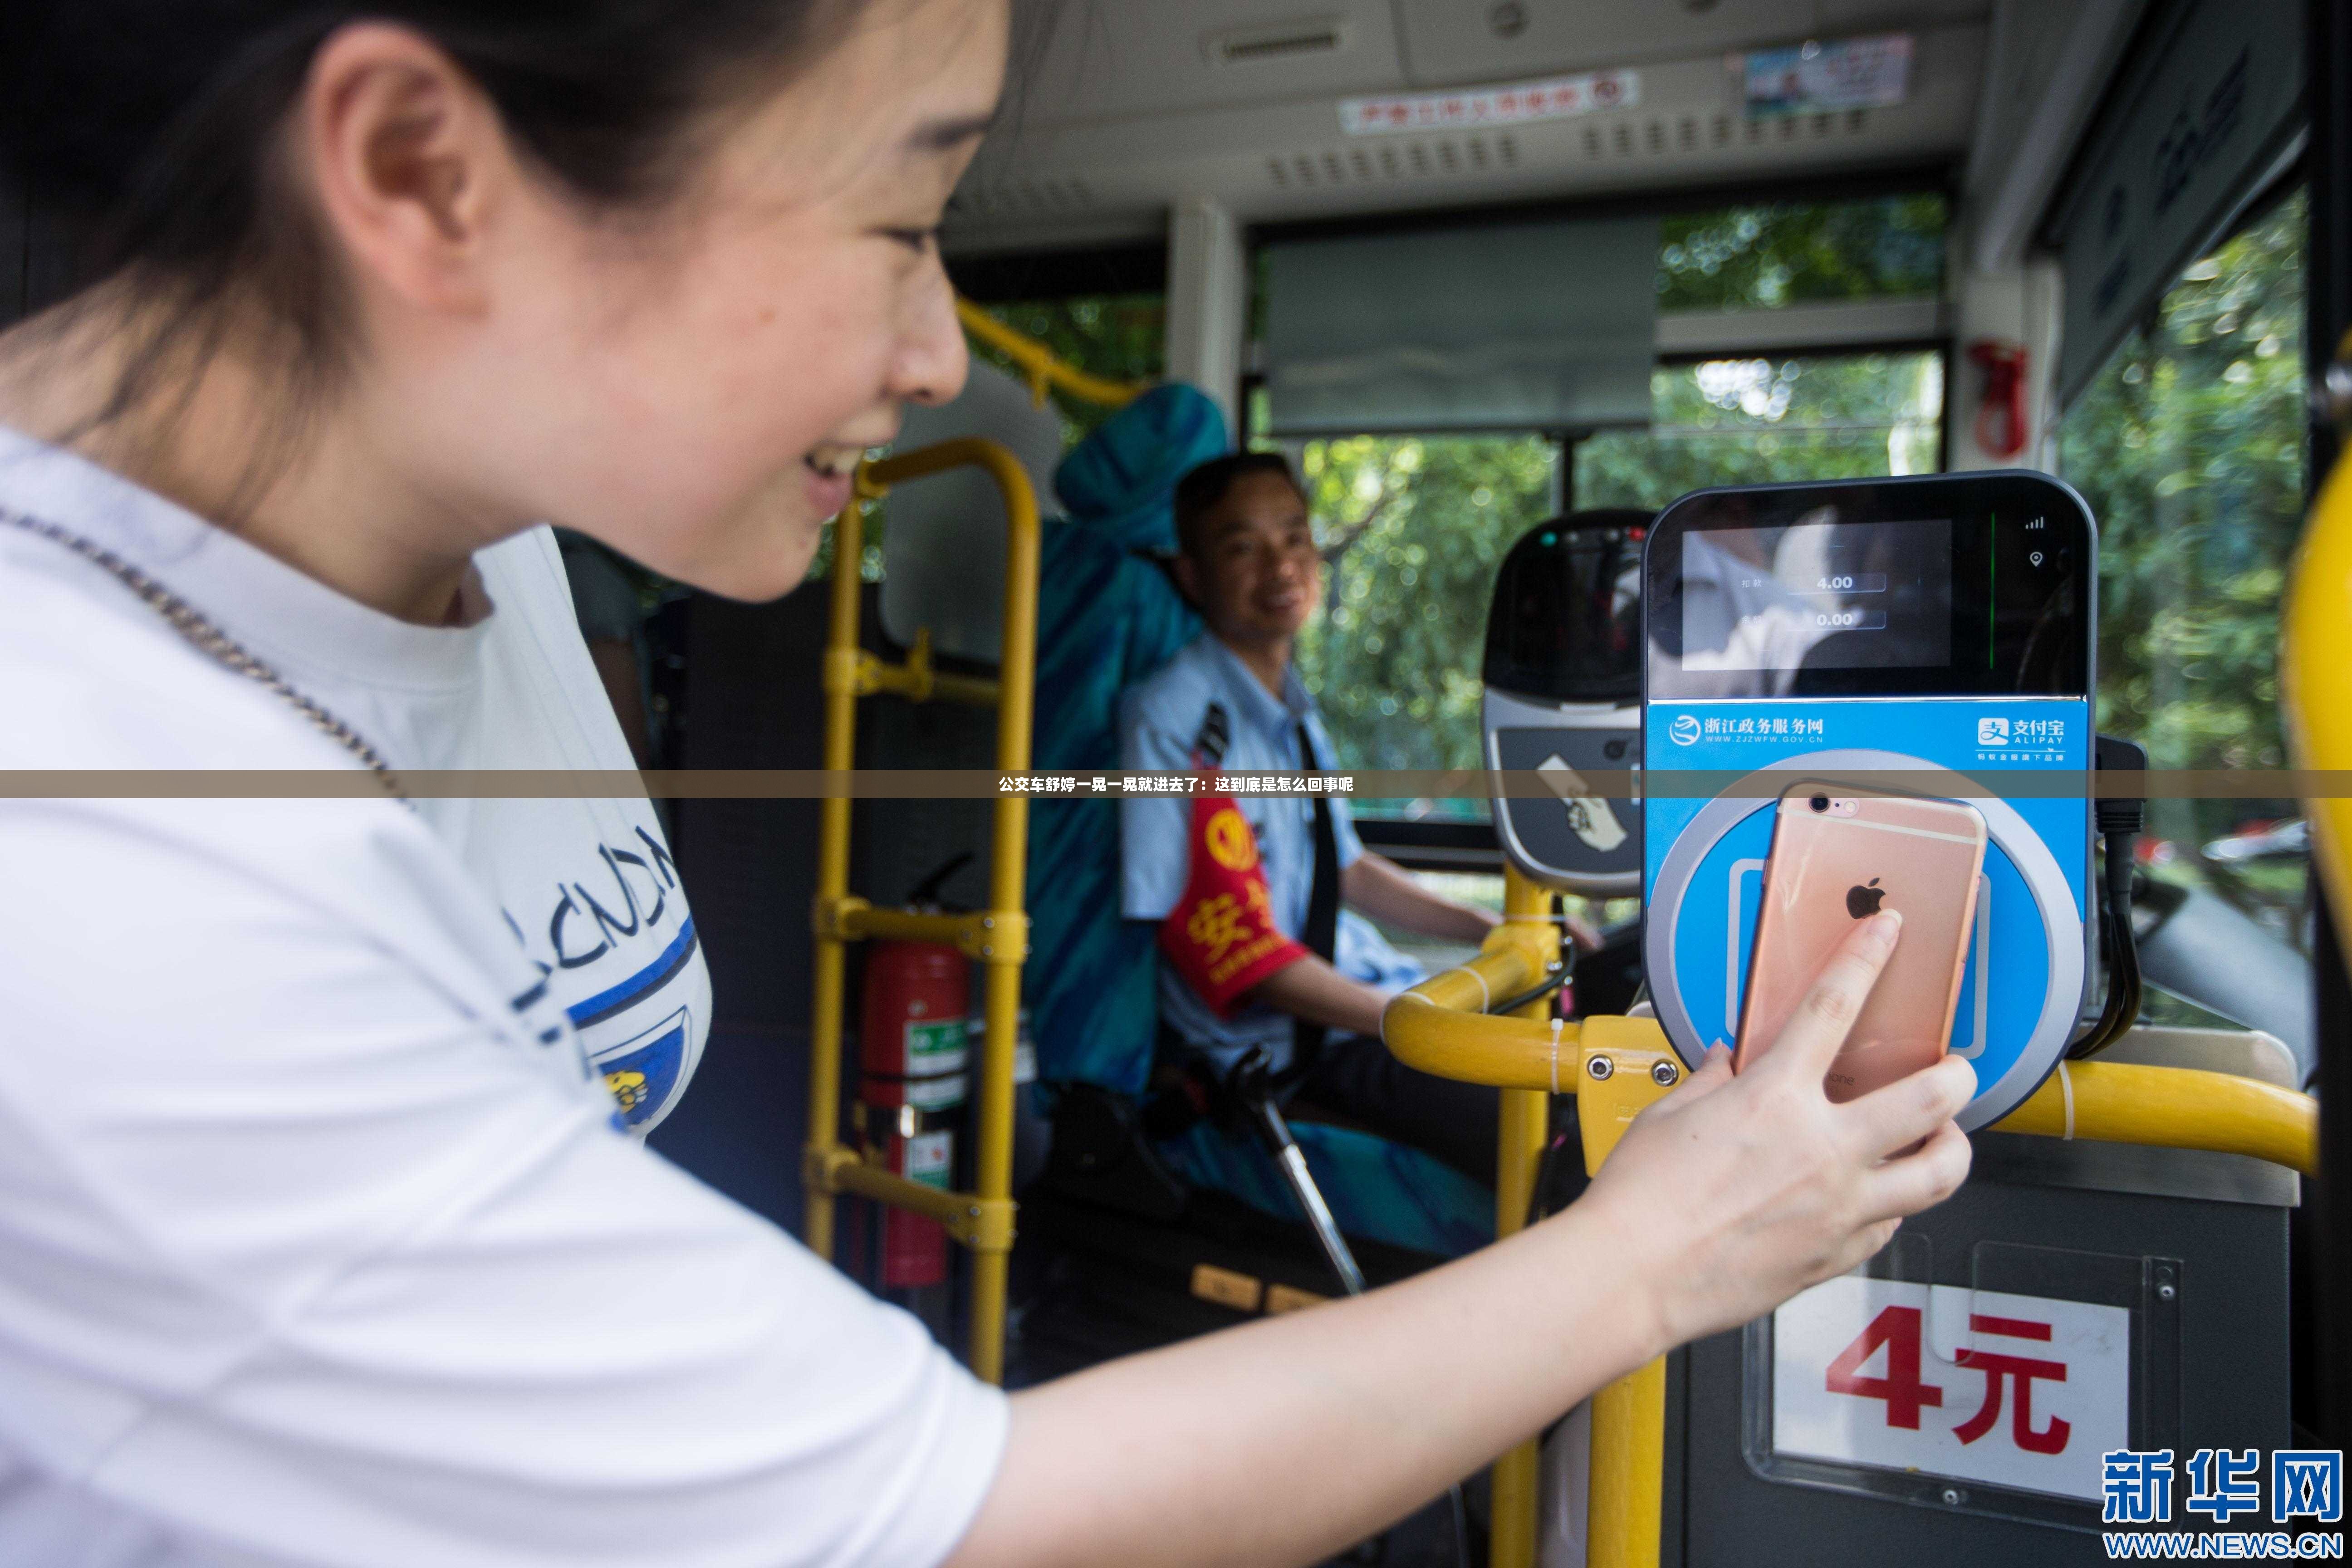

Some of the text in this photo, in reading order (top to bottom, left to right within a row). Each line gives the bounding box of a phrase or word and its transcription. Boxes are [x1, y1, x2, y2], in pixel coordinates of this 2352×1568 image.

[1817, 577, 1852, 588] 4.00
[1816, 613, 1852, 626] 0.00
[1705, 717, 1823, 735] 浙江政务服务网
[2013, 720, 2064, 735] 支付宝
[1825, 1305, 2071, 1455] 4元
